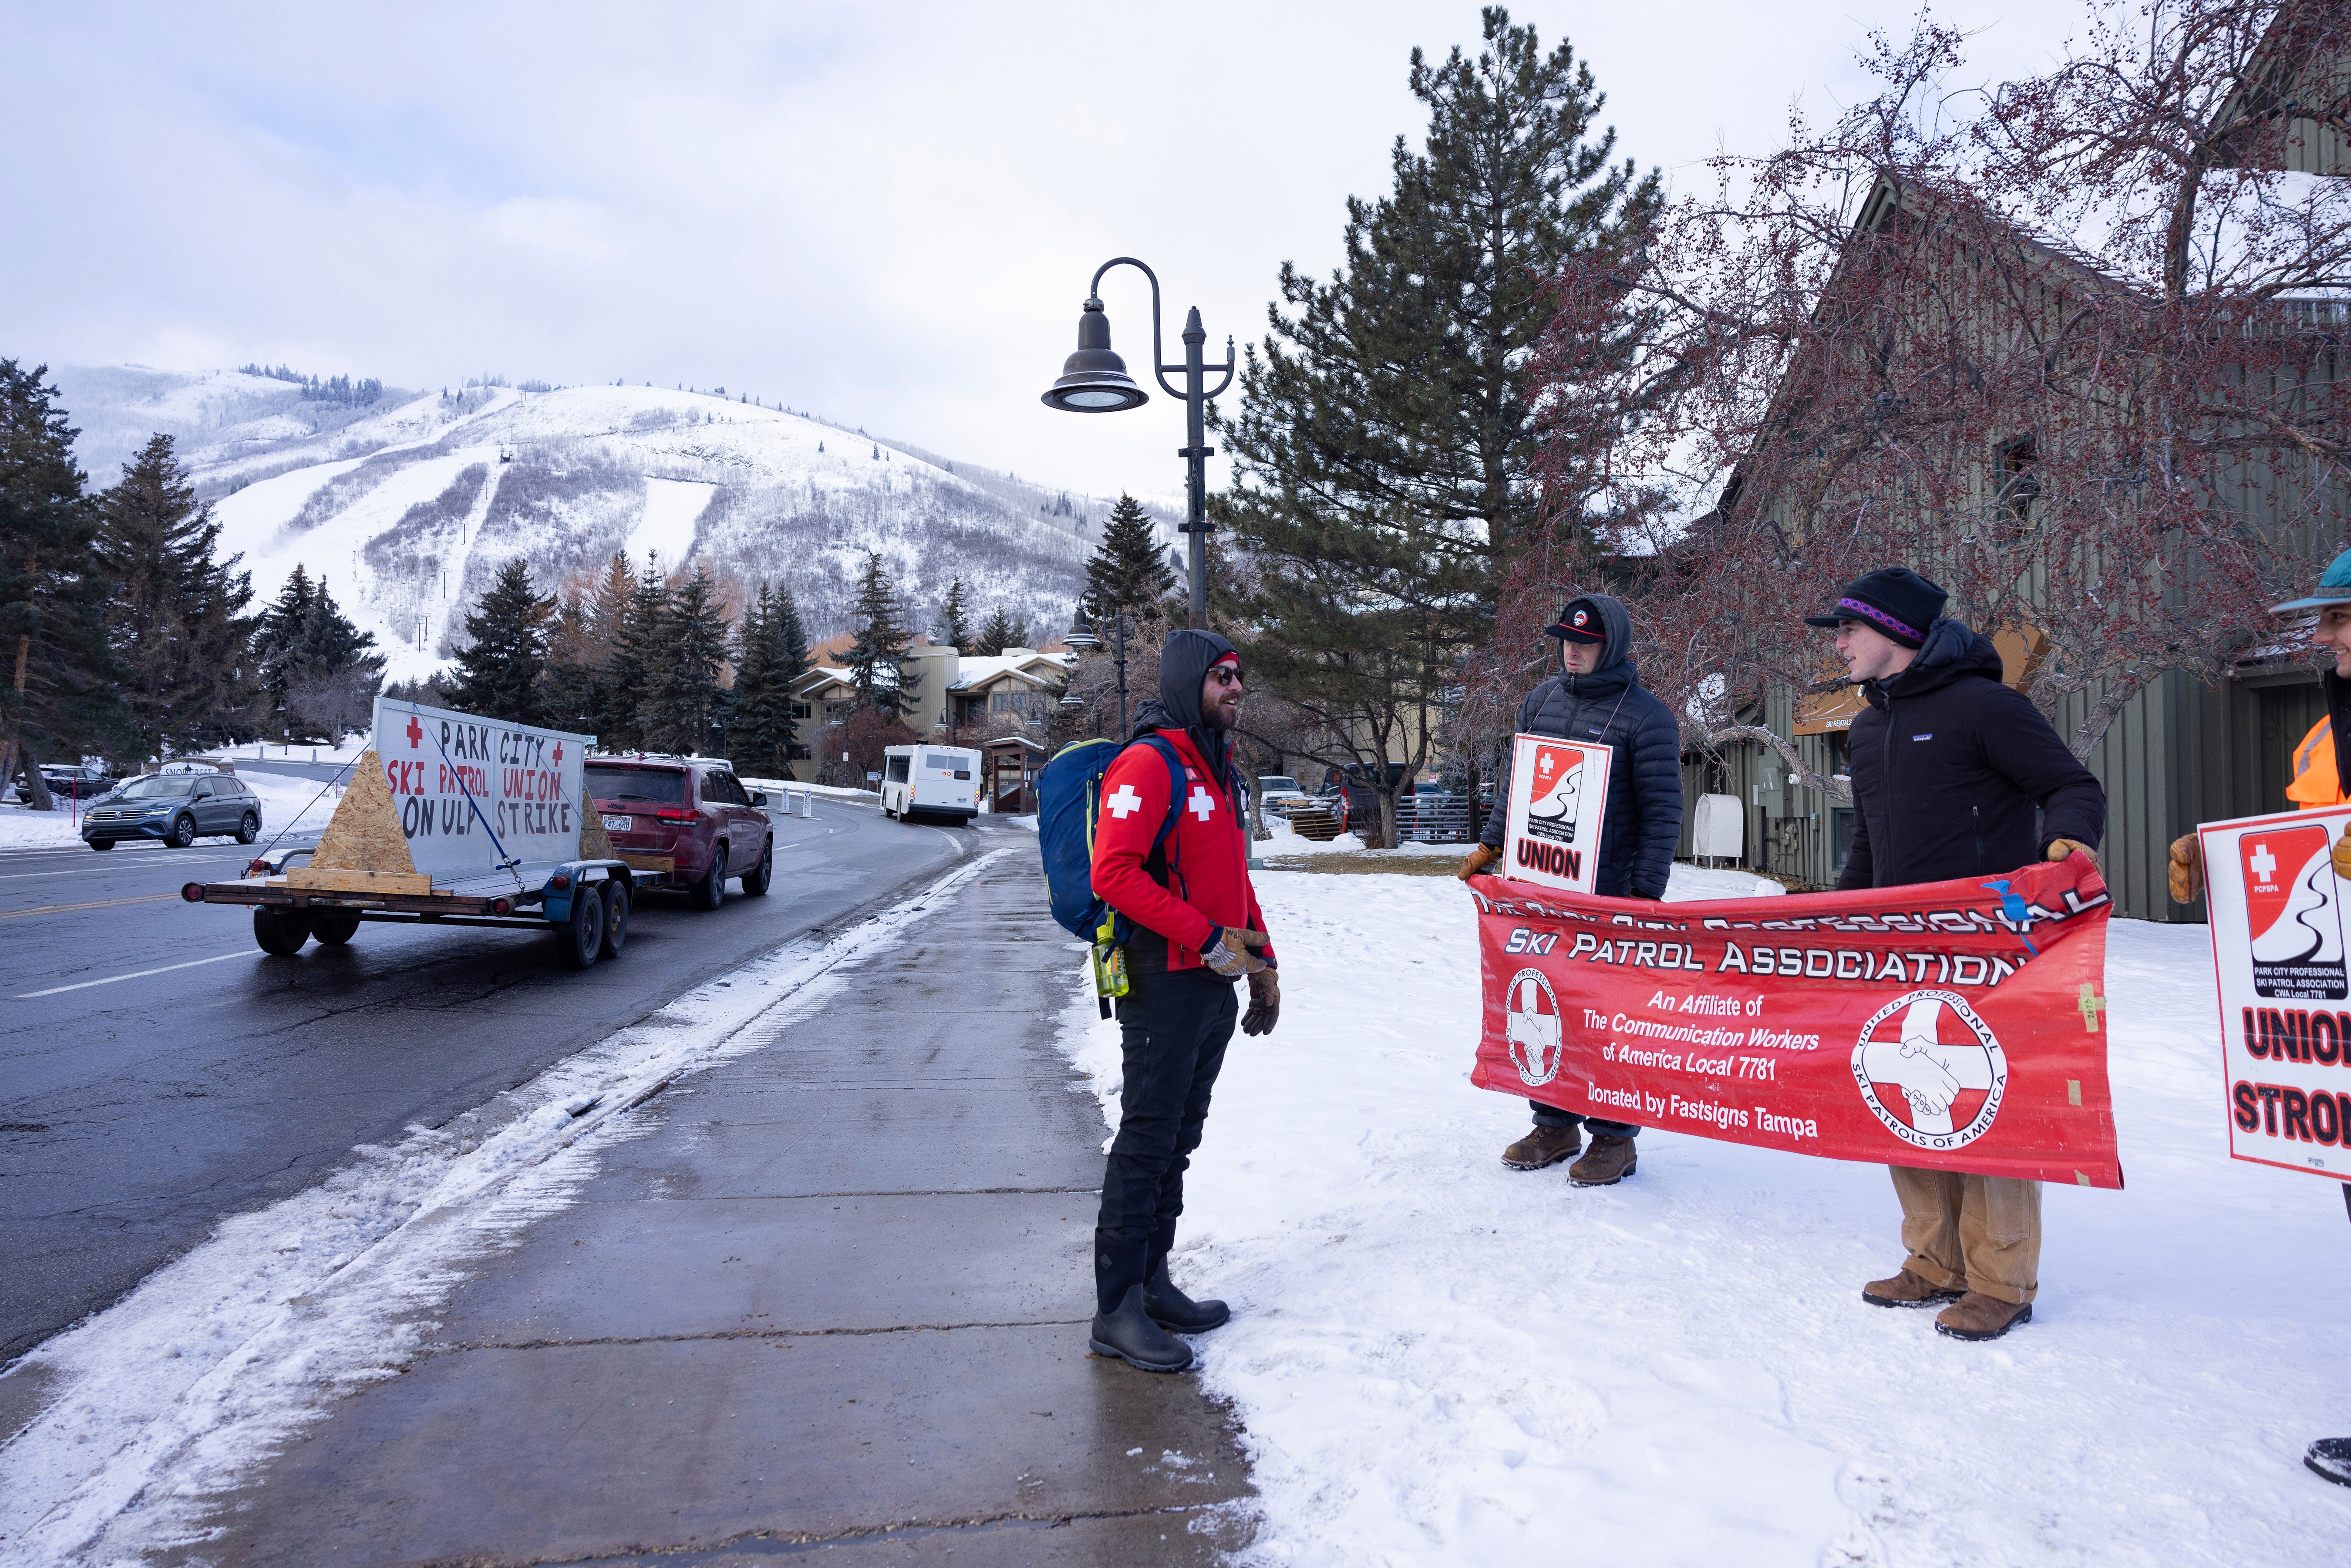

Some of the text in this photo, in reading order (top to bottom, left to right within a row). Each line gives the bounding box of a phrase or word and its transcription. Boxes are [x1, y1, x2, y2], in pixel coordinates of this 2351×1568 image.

[441, 721, 545, 768] PARK CITY
[387, 760, 561, 801] SKI PATROL UNION
[403, 796, 570, 839] ON ULP STRIKE
[1547, 821, 1574, 831] PROFESSIONAL
[1549, 828, 1573, 838] ASSOCIATION
[1517, 838, 1581, 881] UNION
[2254, 885, 2279, 893] PCPSPA
[1505, 928, 2029, 986] SKI PATROL ASSOCIATION
[2254, 967, 2344, 977] PARK CITY PROFESSIONAL
[1506, 969, 1560, 1021] UNITED PROFESSIONAL
[1647, 990, 1764, 1016] An Affiliate of
[2257, 979, 2344, 989] SKI PATROL ASSOCIATION
[2275, 989, 2326, 999] CWA Local 7781
[1583, 1009, 1819, 1051] The Communication Workers
[1859, 990, 1998, 1053] UNITED PROFESSIONAL
[1510, 1050, 1531, 1083] PATROLS
[1532, 1074, 1543, 1084] OF
[1544, 1037, 1562, 1082] AMERICA
[1603, 1044, 1776, 1081] of America Local 7781
[1588, 1082, 1819, 1141] Donated by Fastsigns Tampa
[1853, 1063, 2006, 1147] SKI PATROLS OF AMERICA
